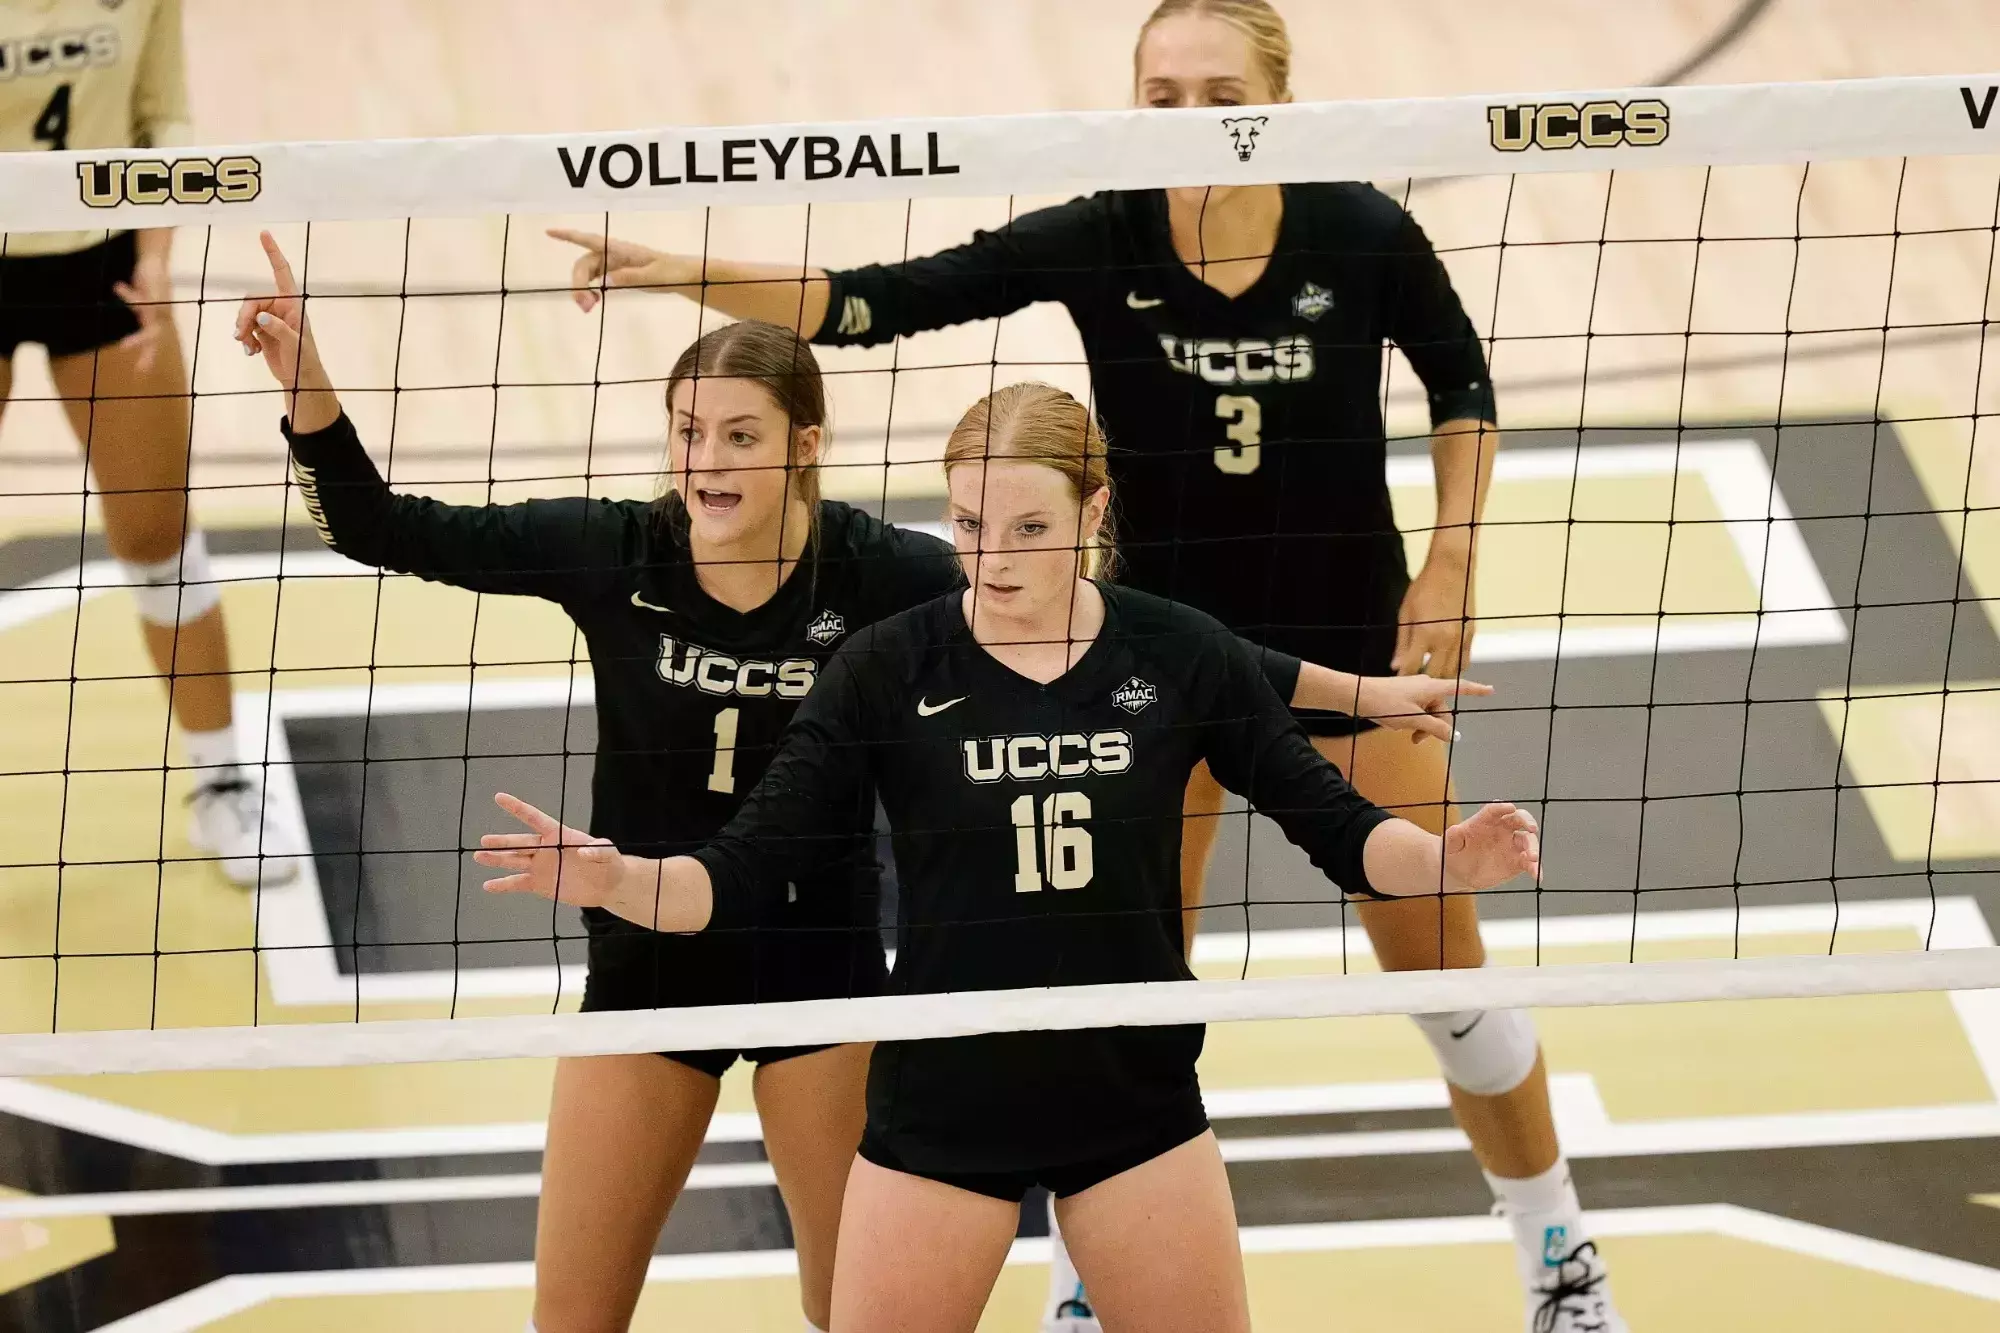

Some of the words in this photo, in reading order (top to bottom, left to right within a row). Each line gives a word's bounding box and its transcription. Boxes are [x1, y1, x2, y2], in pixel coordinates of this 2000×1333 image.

[33, 82, 71, 150] 4
[1487, 100, 1670, 152] UCCS
[1960, 86, 1999, 129] V
[76, 155, 261, 208] UCCS
[557, 131, 960, 189] VOLLEYBALL
[1157, 333, 1315, 385] UCCS
[1213, 394, 1261, 474] 3
[811, 619, 842, 638] RMAC
[655, 632, 818, 699] UCCS
[1116, 688, 1154, 704] RMAC
[708, 707, 739, 794] 1
[960, 728, 1134, 784] UCCS
[1011, 791, 1094, 893] 16
